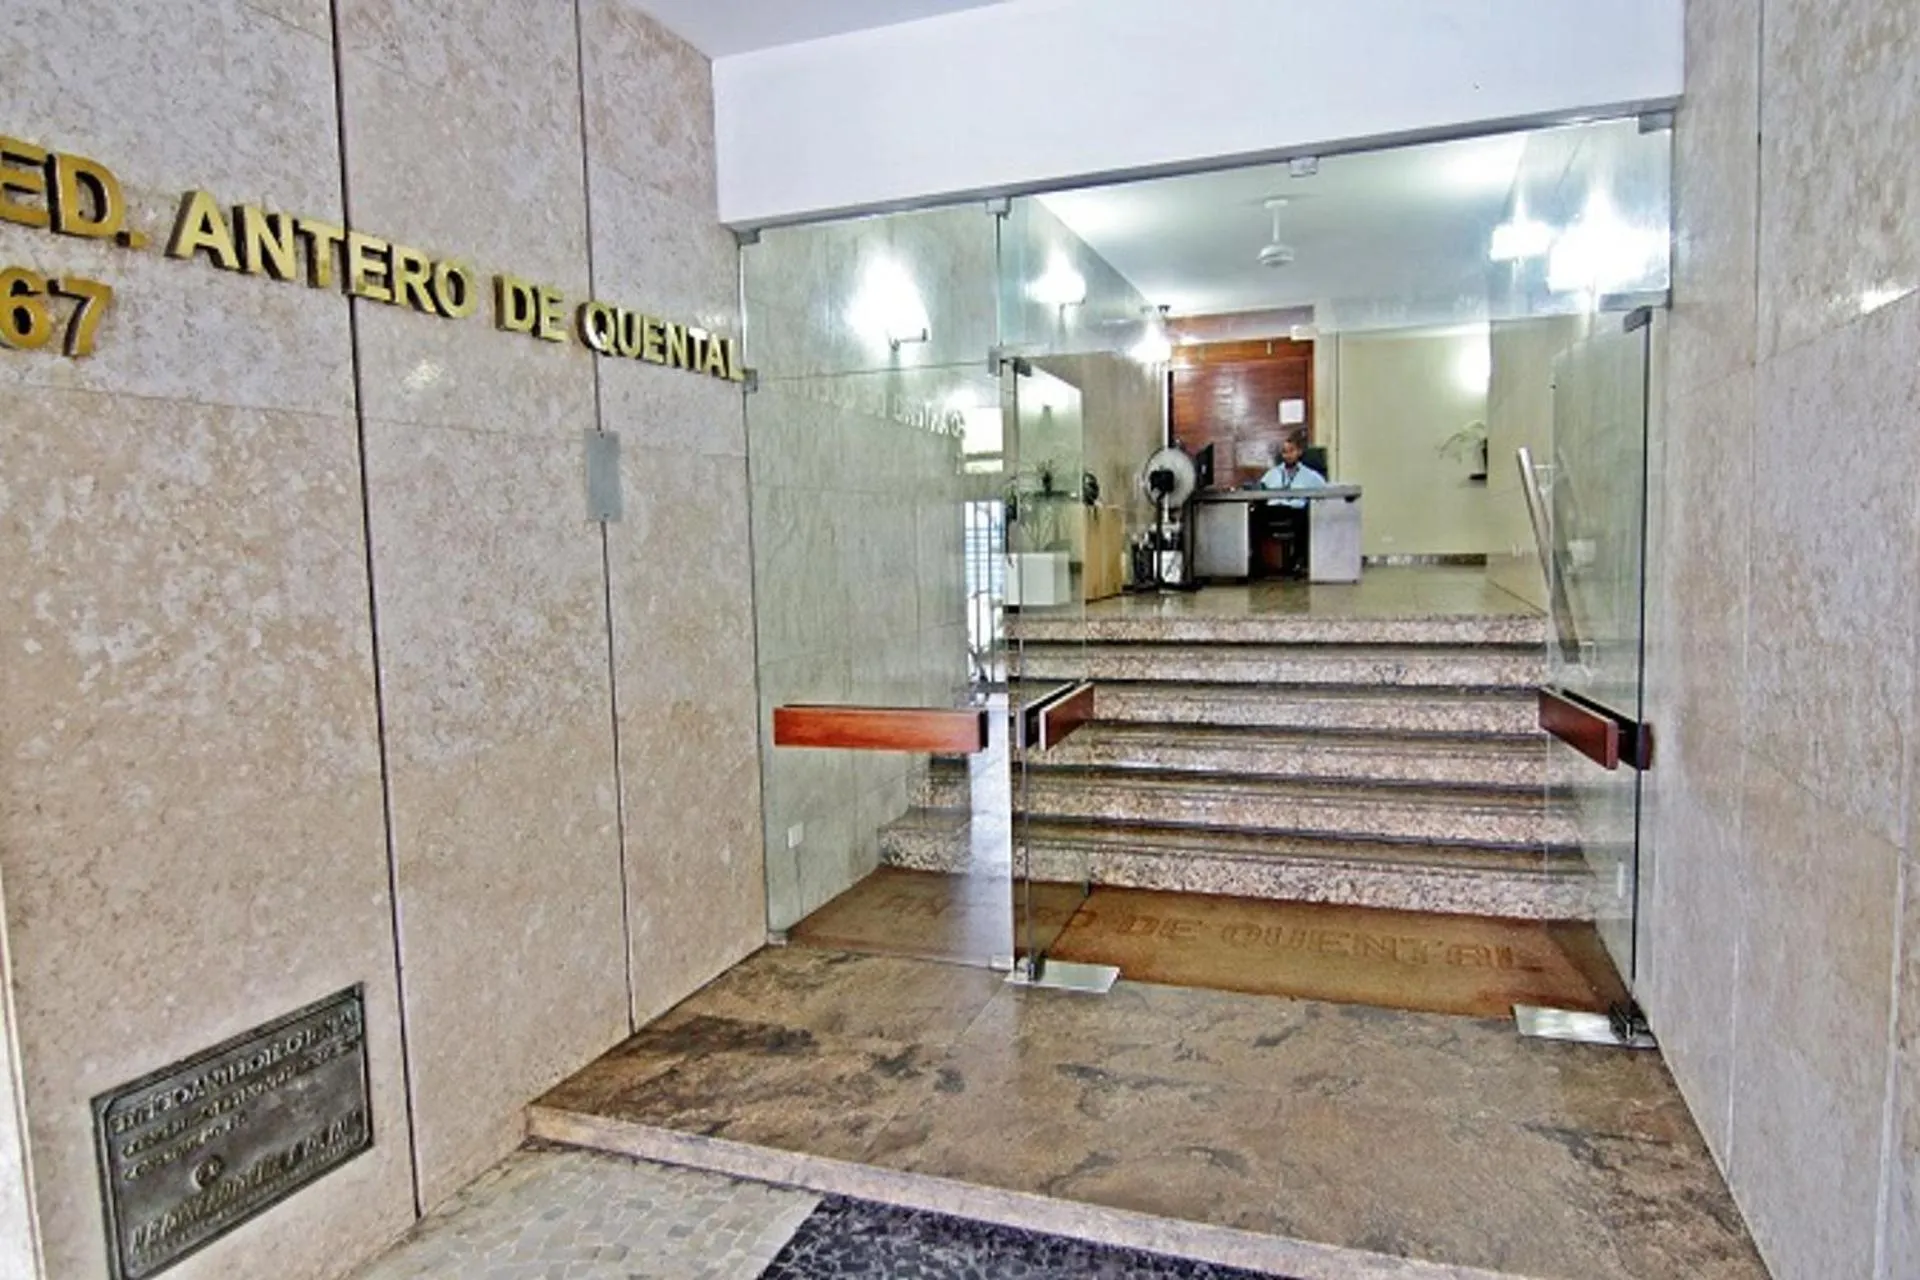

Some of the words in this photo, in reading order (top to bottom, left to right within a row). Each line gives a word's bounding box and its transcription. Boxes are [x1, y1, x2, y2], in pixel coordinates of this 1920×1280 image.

[0, 133, 149, 250] ED.
[165, 188, 477, 320] ANTERO
[493, 275, 567, 343] DE
[576, 300, 745, 382] QUENTAL
[0, 266, 113, 358] 67
